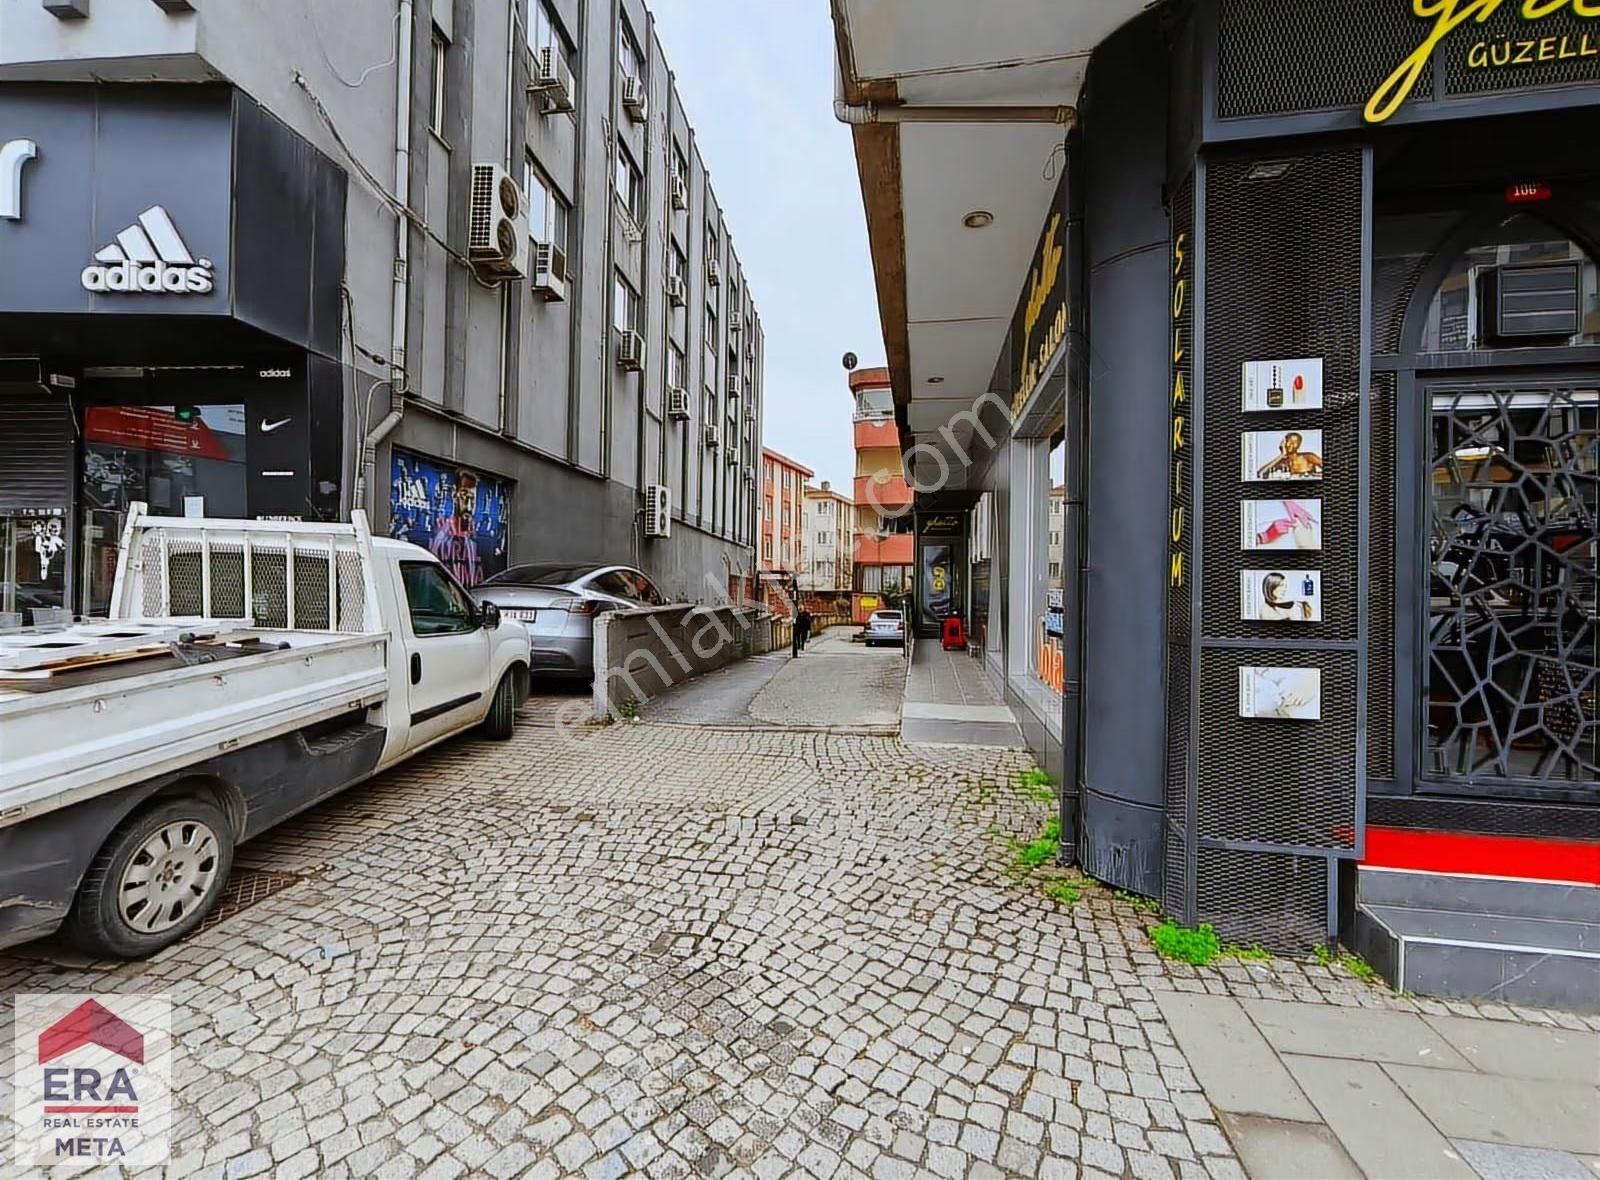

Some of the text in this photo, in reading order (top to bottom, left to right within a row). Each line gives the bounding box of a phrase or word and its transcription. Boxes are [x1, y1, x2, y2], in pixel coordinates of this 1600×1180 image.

[1467, 34, 1598, 68] GÜZELL
[81, 259, 213, 293] adidas
[259, 368, 291, 378] adidas
[1171, 233, 1186, 587] SOLARIUM
